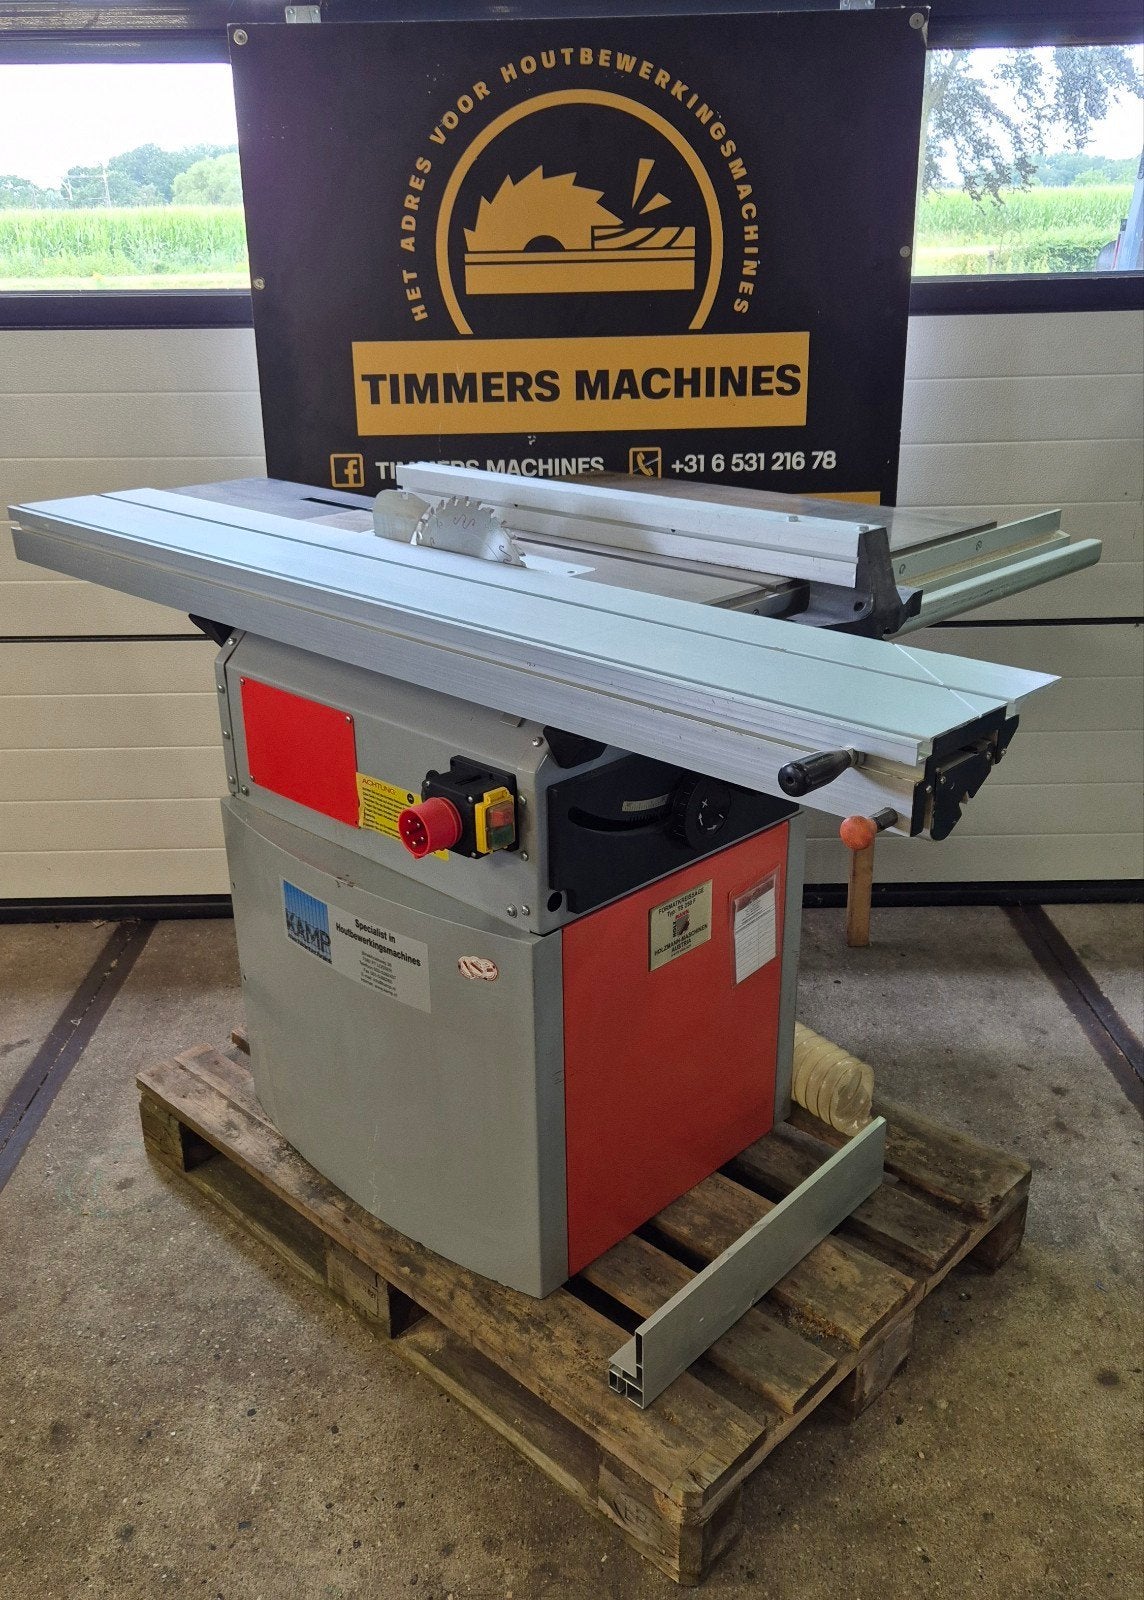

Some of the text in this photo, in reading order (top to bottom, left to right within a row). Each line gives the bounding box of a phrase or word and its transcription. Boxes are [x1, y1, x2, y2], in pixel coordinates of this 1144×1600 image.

[400, 47, 759, 322] HET ADRES VOOR HOUTBEWERKINGSMACHINES
[361, 363, 802, 405] TIMMERS MACHINES
[486, 456, 605, 477] MACHINES
[671, 450, 837, 473] +31 6 531 216 78
[335, 921, 422, 967] Houtbewerkingsmachines
[354, 918, 396, 944] Specialist in
